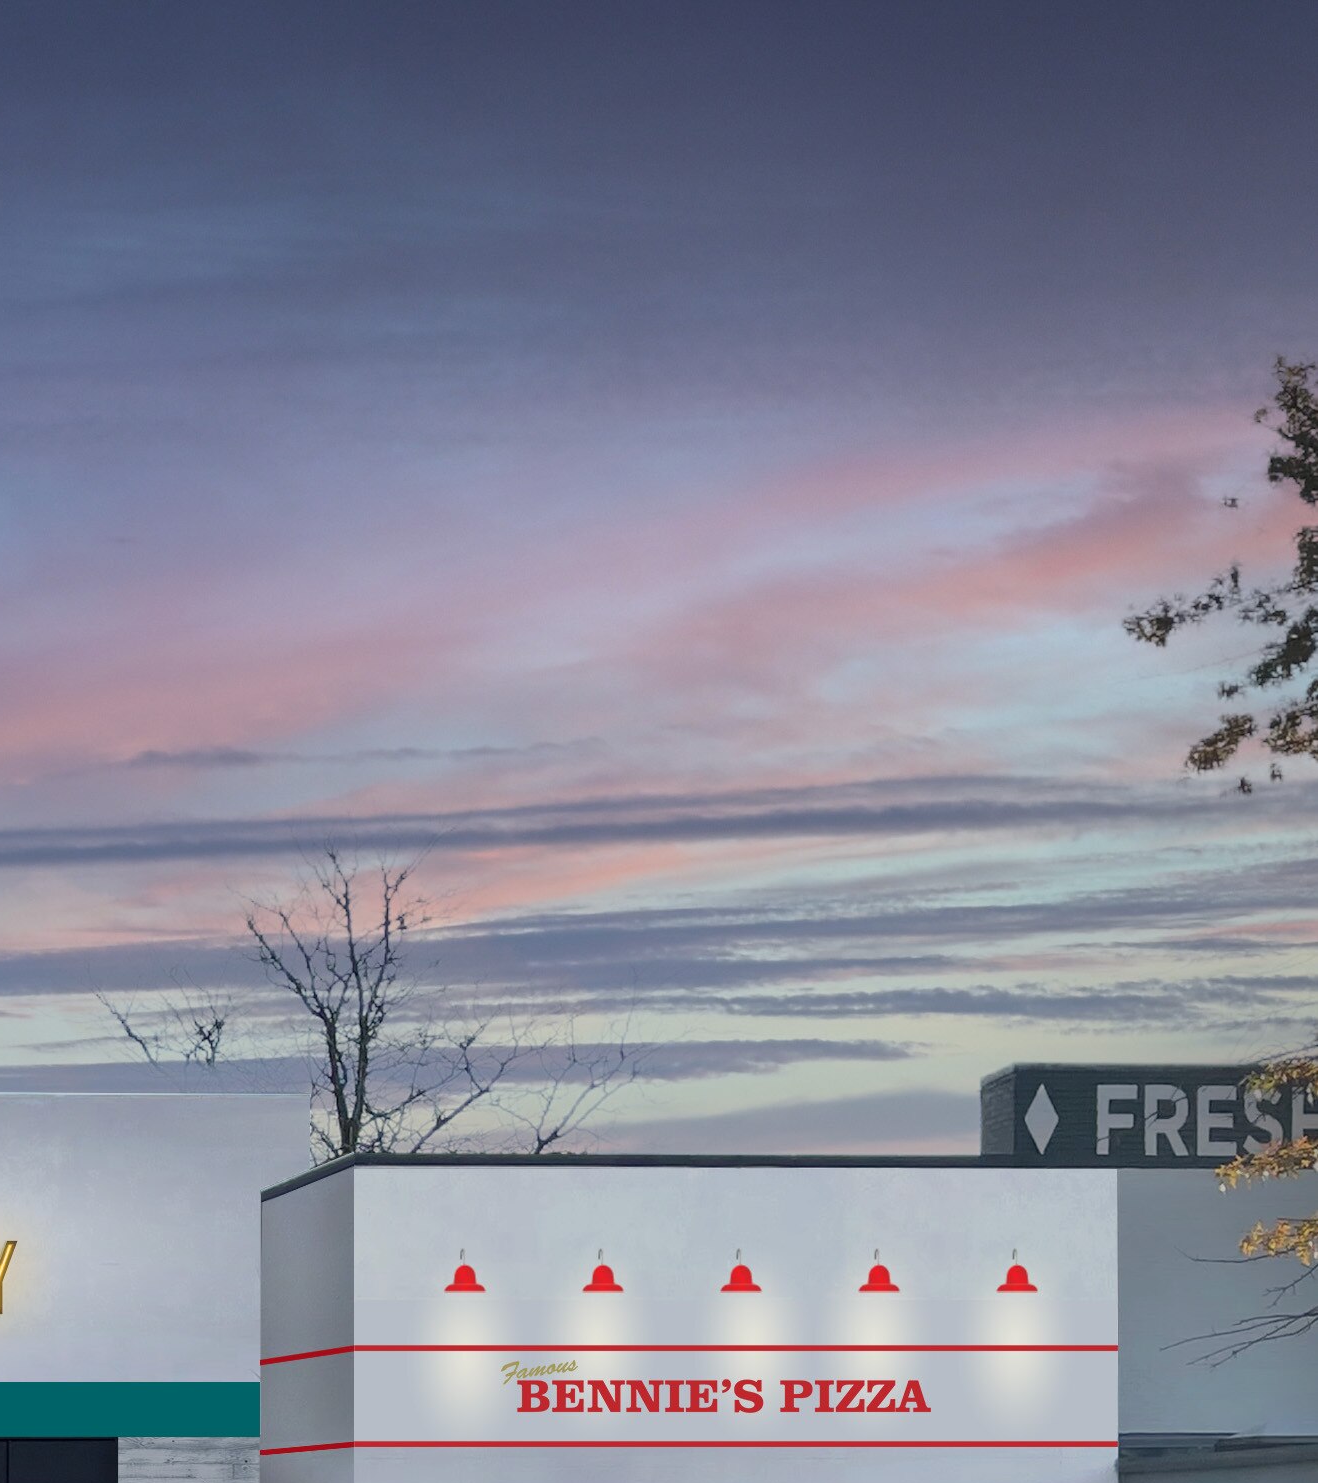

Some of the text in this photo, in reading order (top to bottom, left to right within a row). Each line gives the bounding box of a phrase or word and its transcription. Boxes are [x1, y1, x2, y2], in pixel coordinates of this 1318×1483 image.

[501, 1359, 579, 1386] Famous
[516, 1378, 931, 1414] BENNIE'S PIZZA
